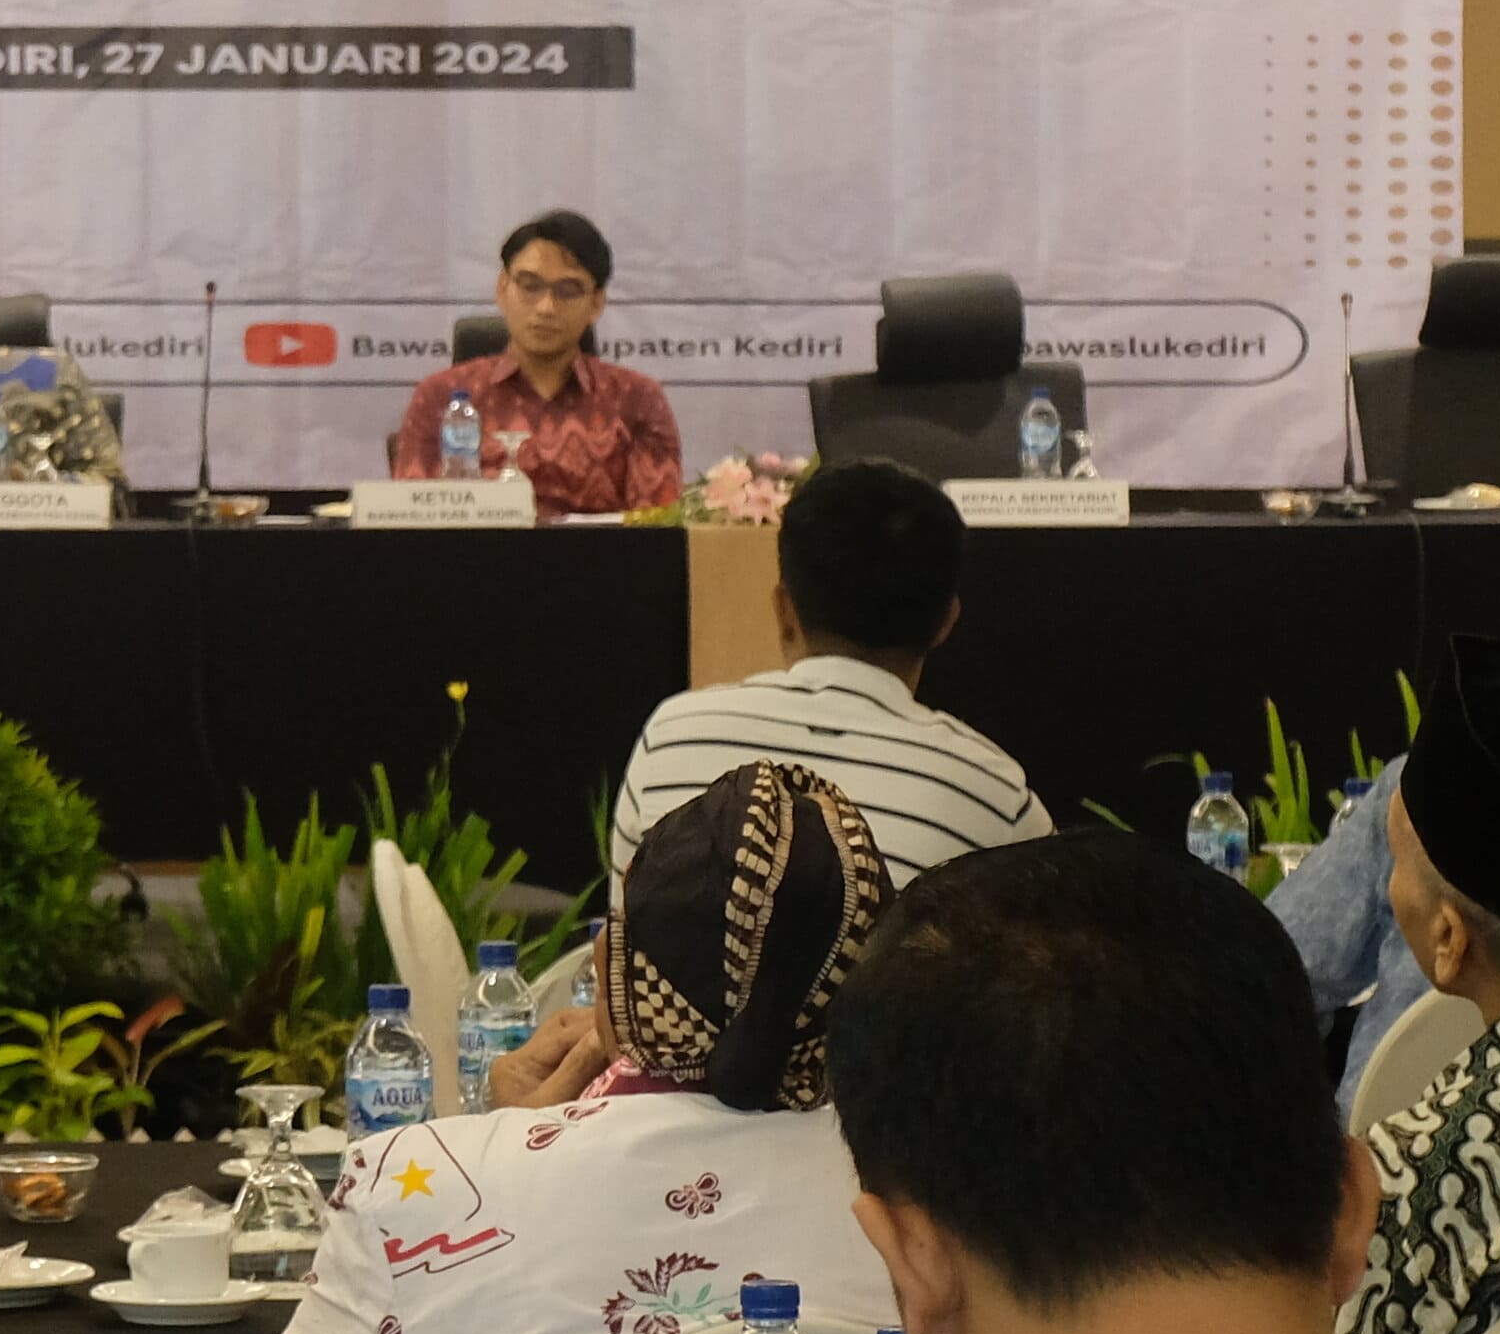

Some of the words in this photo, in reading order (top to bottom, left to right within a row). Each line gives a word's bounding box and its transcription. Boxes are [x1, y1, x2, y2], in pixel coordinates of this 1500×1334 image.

[102, 41, 165, 76] 27
[175, 42, 421, 75] JANUARI
[433, 41, 569, 75] 2024
[352, 334, 450, 358] Bawa
[733, 334, 843, 358] Kediri
[411, 490, 476, 505] KETUA
[372, 1087, 424, 1108] AQUA
